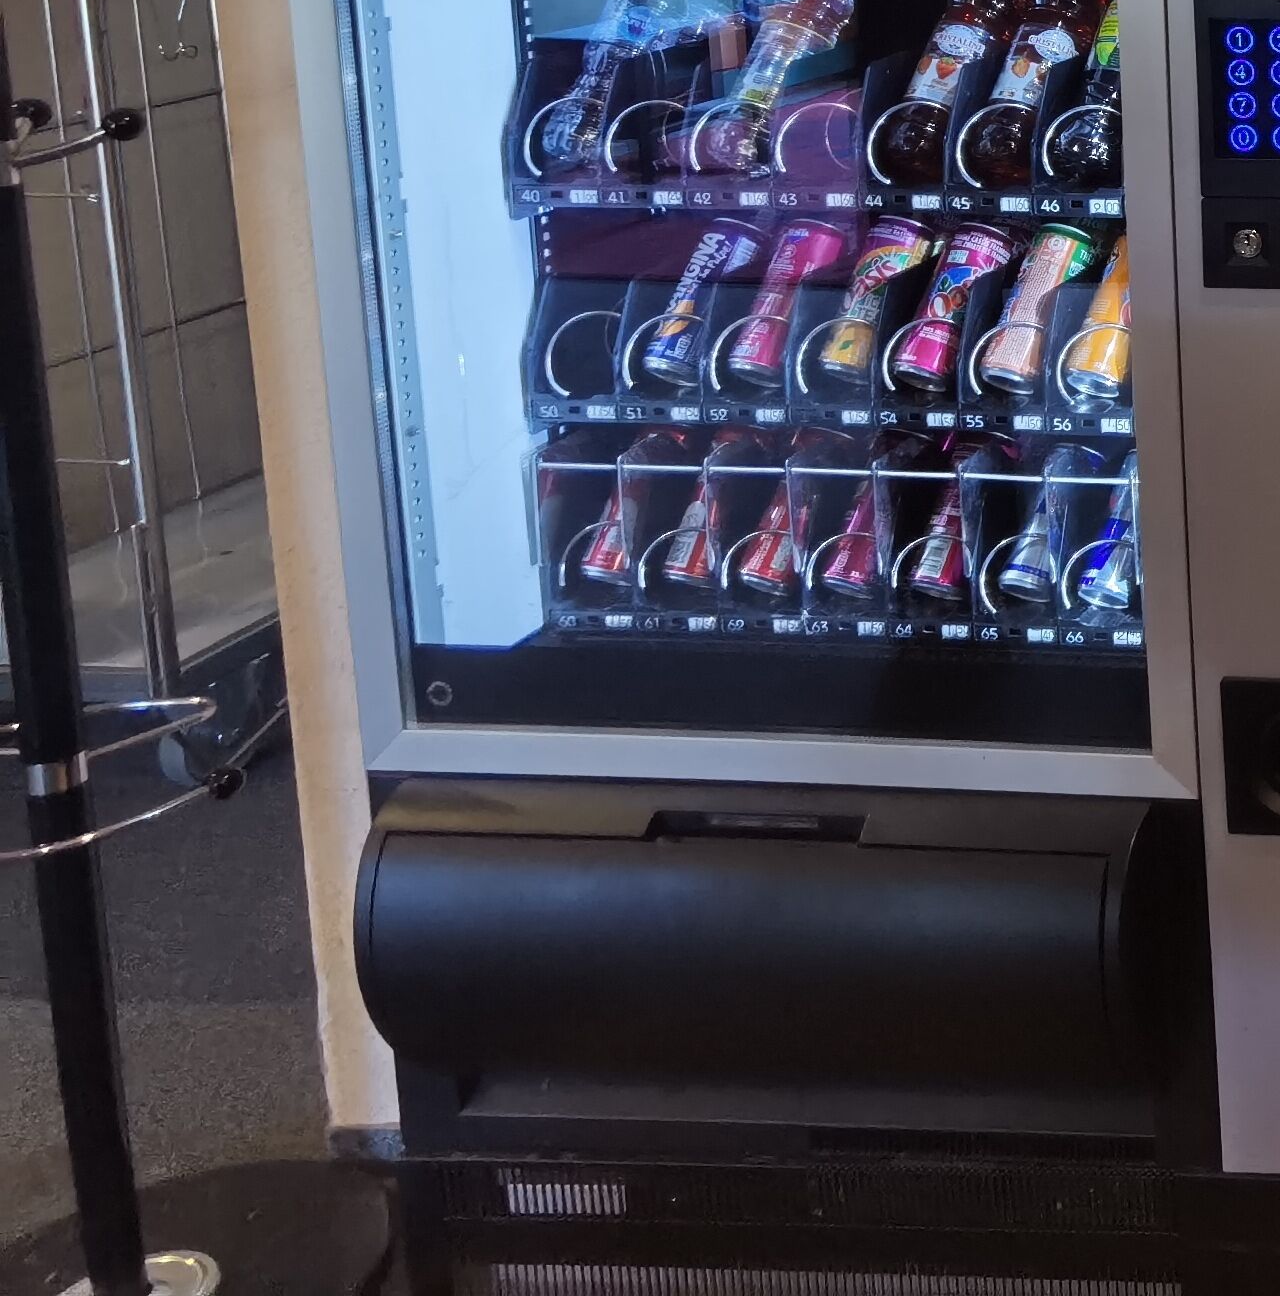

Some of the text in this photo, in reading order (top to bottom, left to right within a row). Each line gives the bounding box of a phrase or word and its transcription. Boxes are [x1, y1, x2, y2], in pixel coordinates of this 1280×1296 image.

[521, 189, 540, 202] 40
[608, 190, 625, 204] 41
[694, 192, 712, 205] 42
[779, 193, 798, 206] 43
[865, 194, 883, 208] 44
[951, 196, 971, 210] 45
[1040, 199, 1060, 212] 46
[626, 407, 642, 420] 51
[710, 408, 728, 421] 52
[879, 411, 898, 425] 54
[966, 414, 984, 428] 55
[1053, 417, 1072, 431] 56
[895, 623, 913, 636] 64
[980, 627, 999, 640] 65
[1065, 631, 1084, 644] 66
